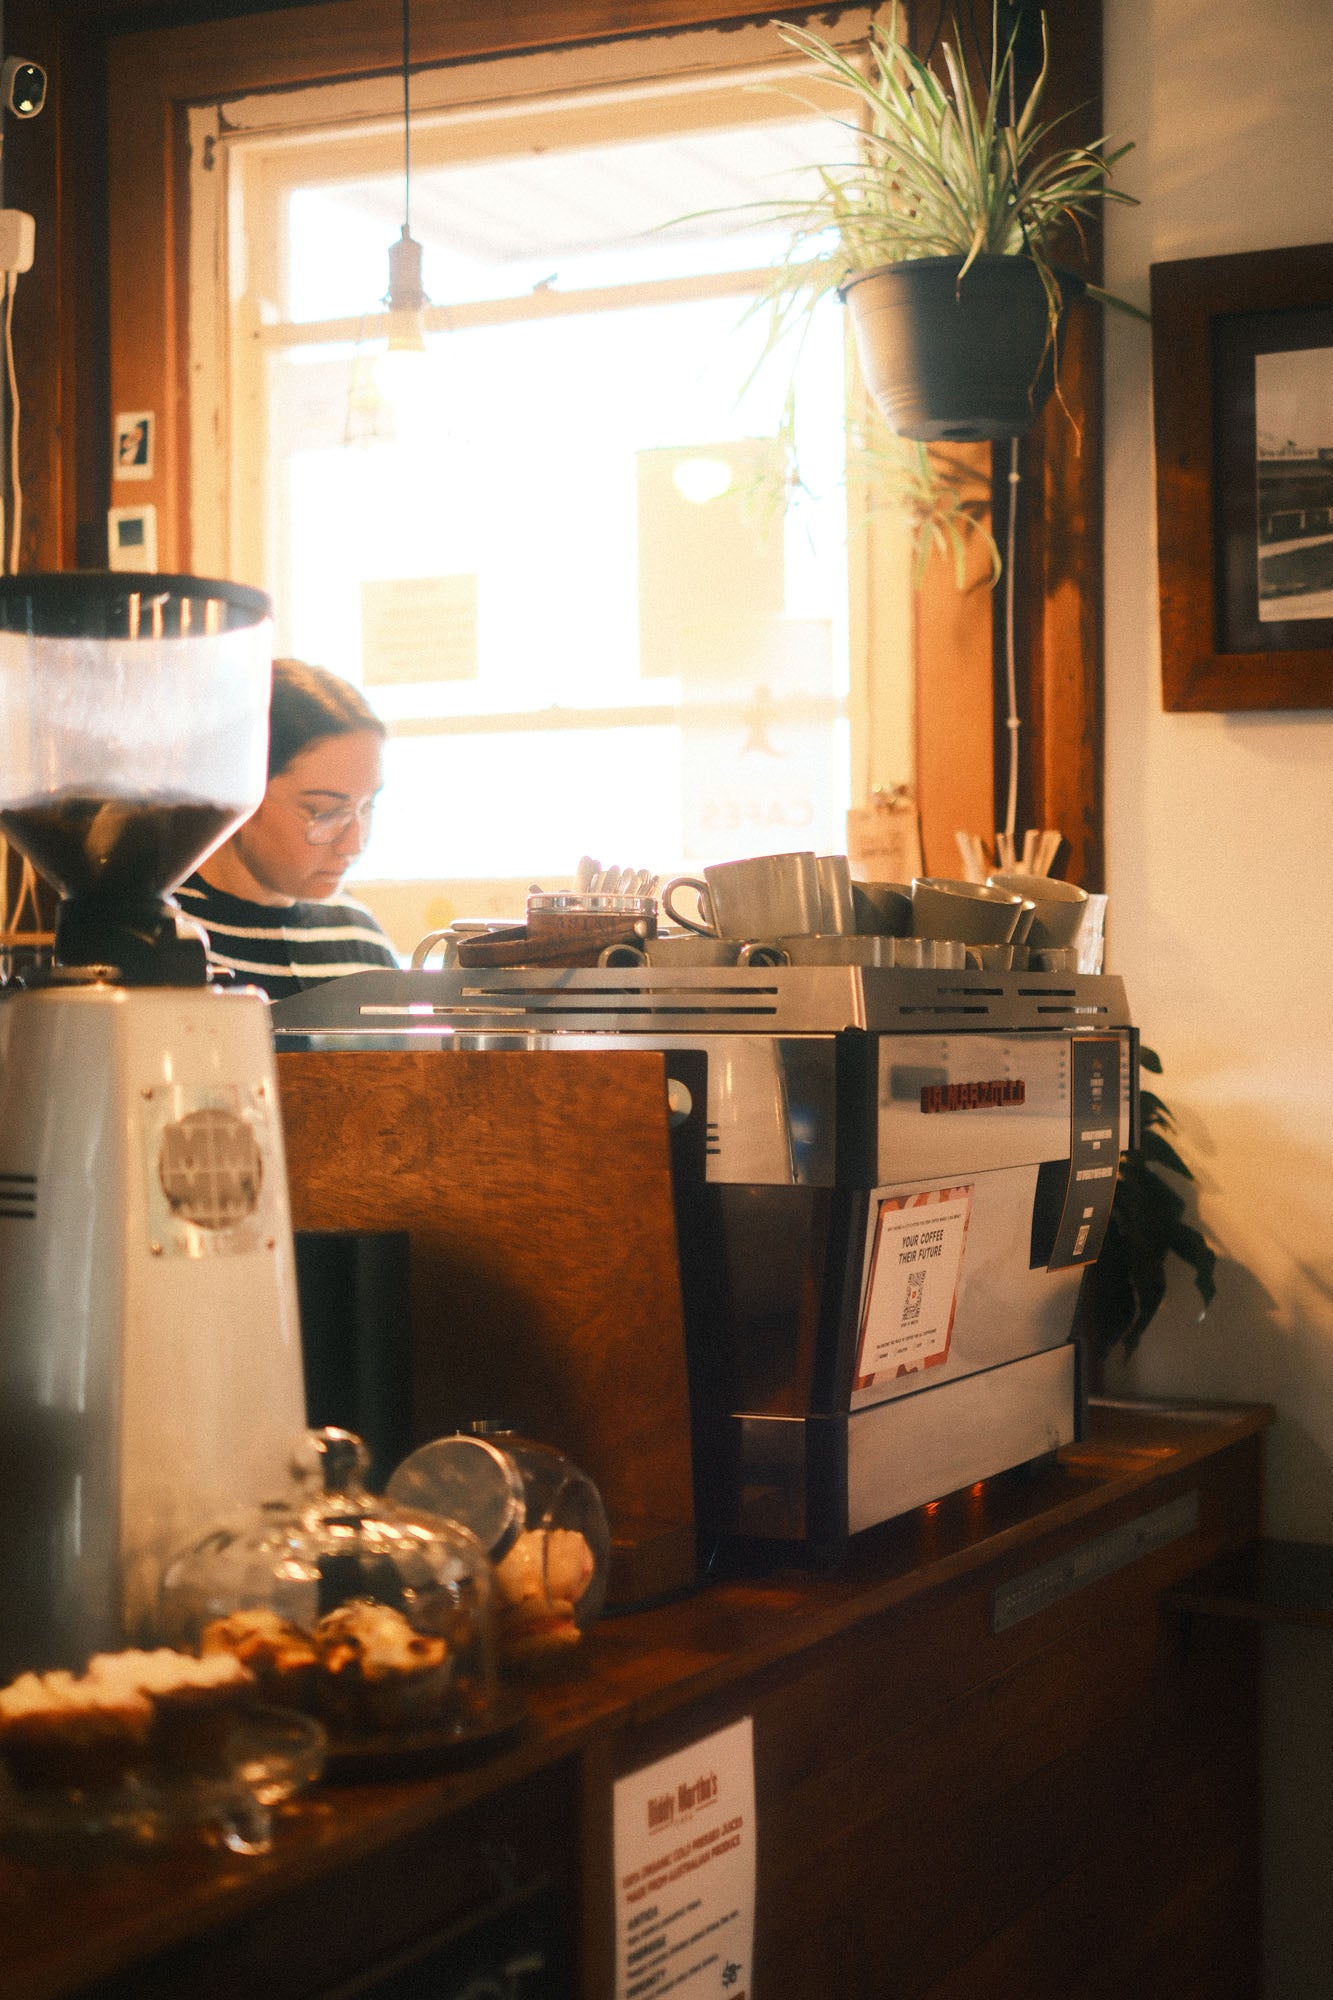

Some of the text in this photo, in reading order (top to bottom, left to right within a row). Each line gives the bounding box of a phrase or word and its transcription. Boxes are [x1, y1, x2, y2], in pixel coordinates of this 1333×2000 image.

[902, 1229, 944, 1248] YOUR COFFEE
[899, 1245, 942, 1264] THEIR FUTURE
